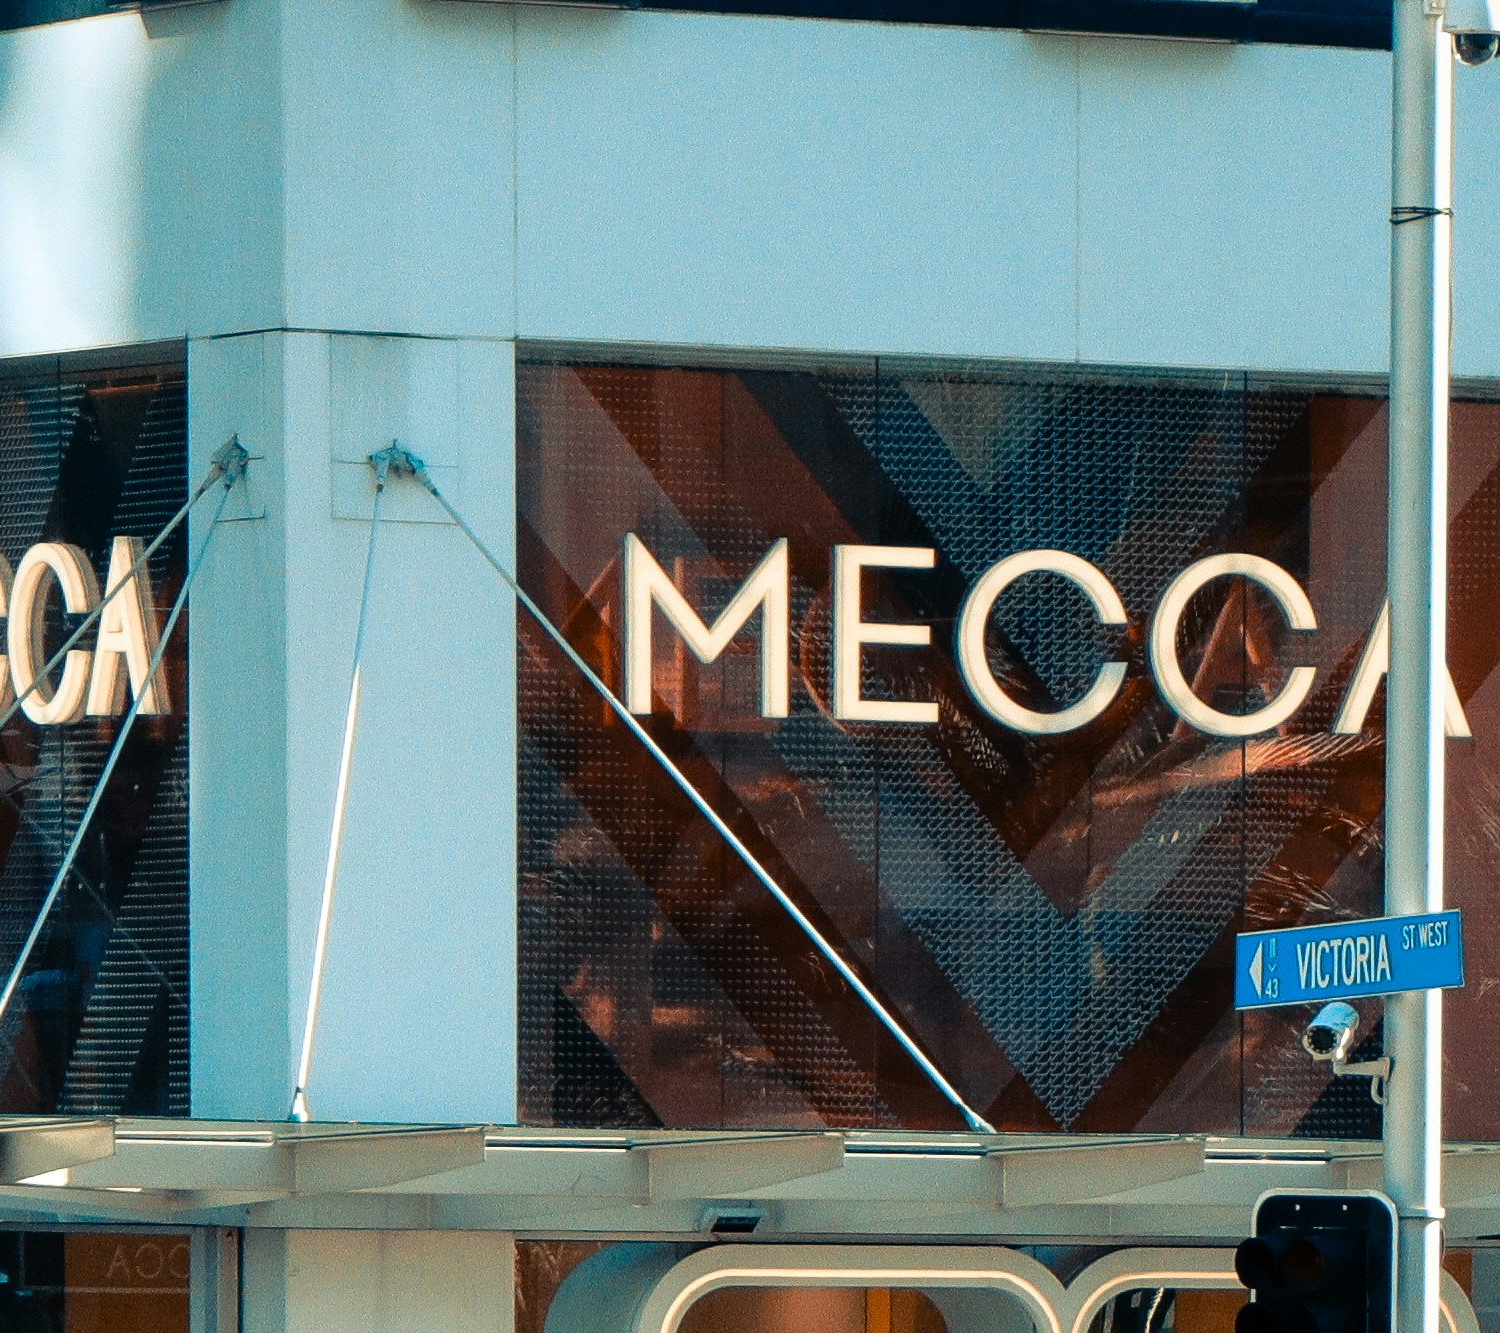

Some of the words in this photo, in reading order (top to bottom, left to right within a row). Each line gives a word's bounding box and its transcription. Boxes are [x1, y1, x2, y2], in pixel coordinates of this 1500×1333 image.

[622, 532, 1472, 738] MECCA
[1265, 978, 1278, 999] 43
[1297, 935, 1394, 989] VICTORIA
[1402, 925, 1416, 949] ST
[1419, 921, 1448, 948] WEST
